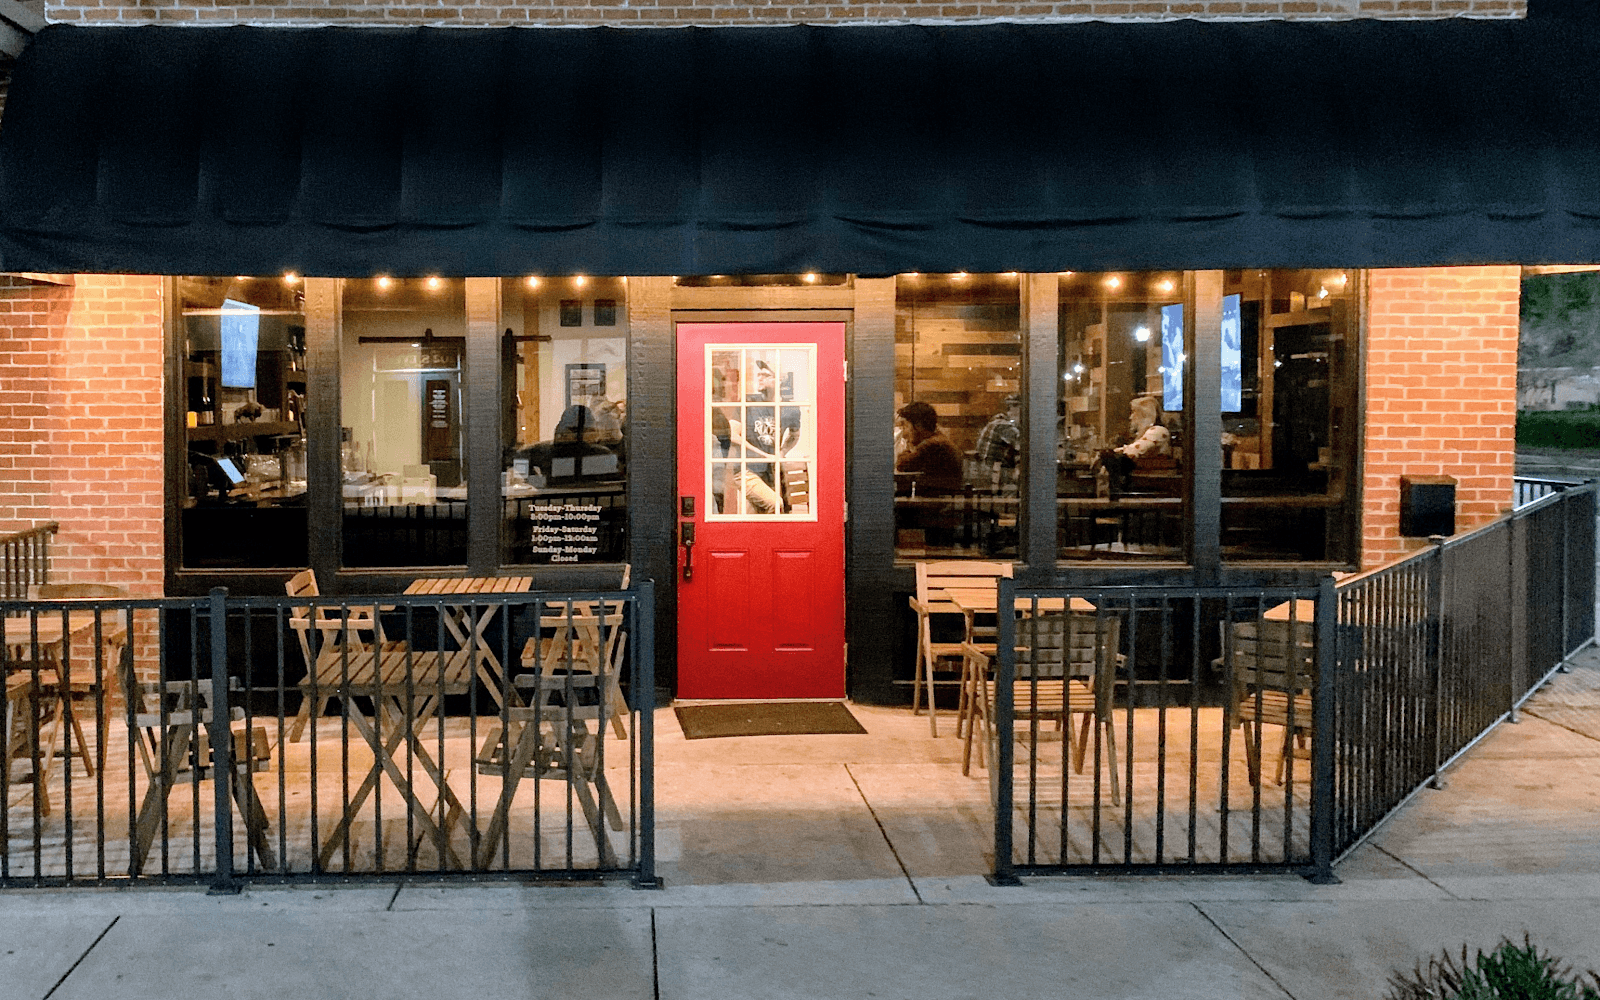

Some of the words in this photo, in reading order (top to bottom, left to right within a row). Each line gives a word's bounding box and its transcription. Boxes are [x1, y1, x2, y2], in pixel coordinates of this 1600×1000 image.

[528, 504, 602, 513] Tuesday-Thursday
[532, 525, 597, 534] Friday-Saturday
[532, 546, 597, 554] Sunday-Monday
[551, 554, 578, 562] Closed
